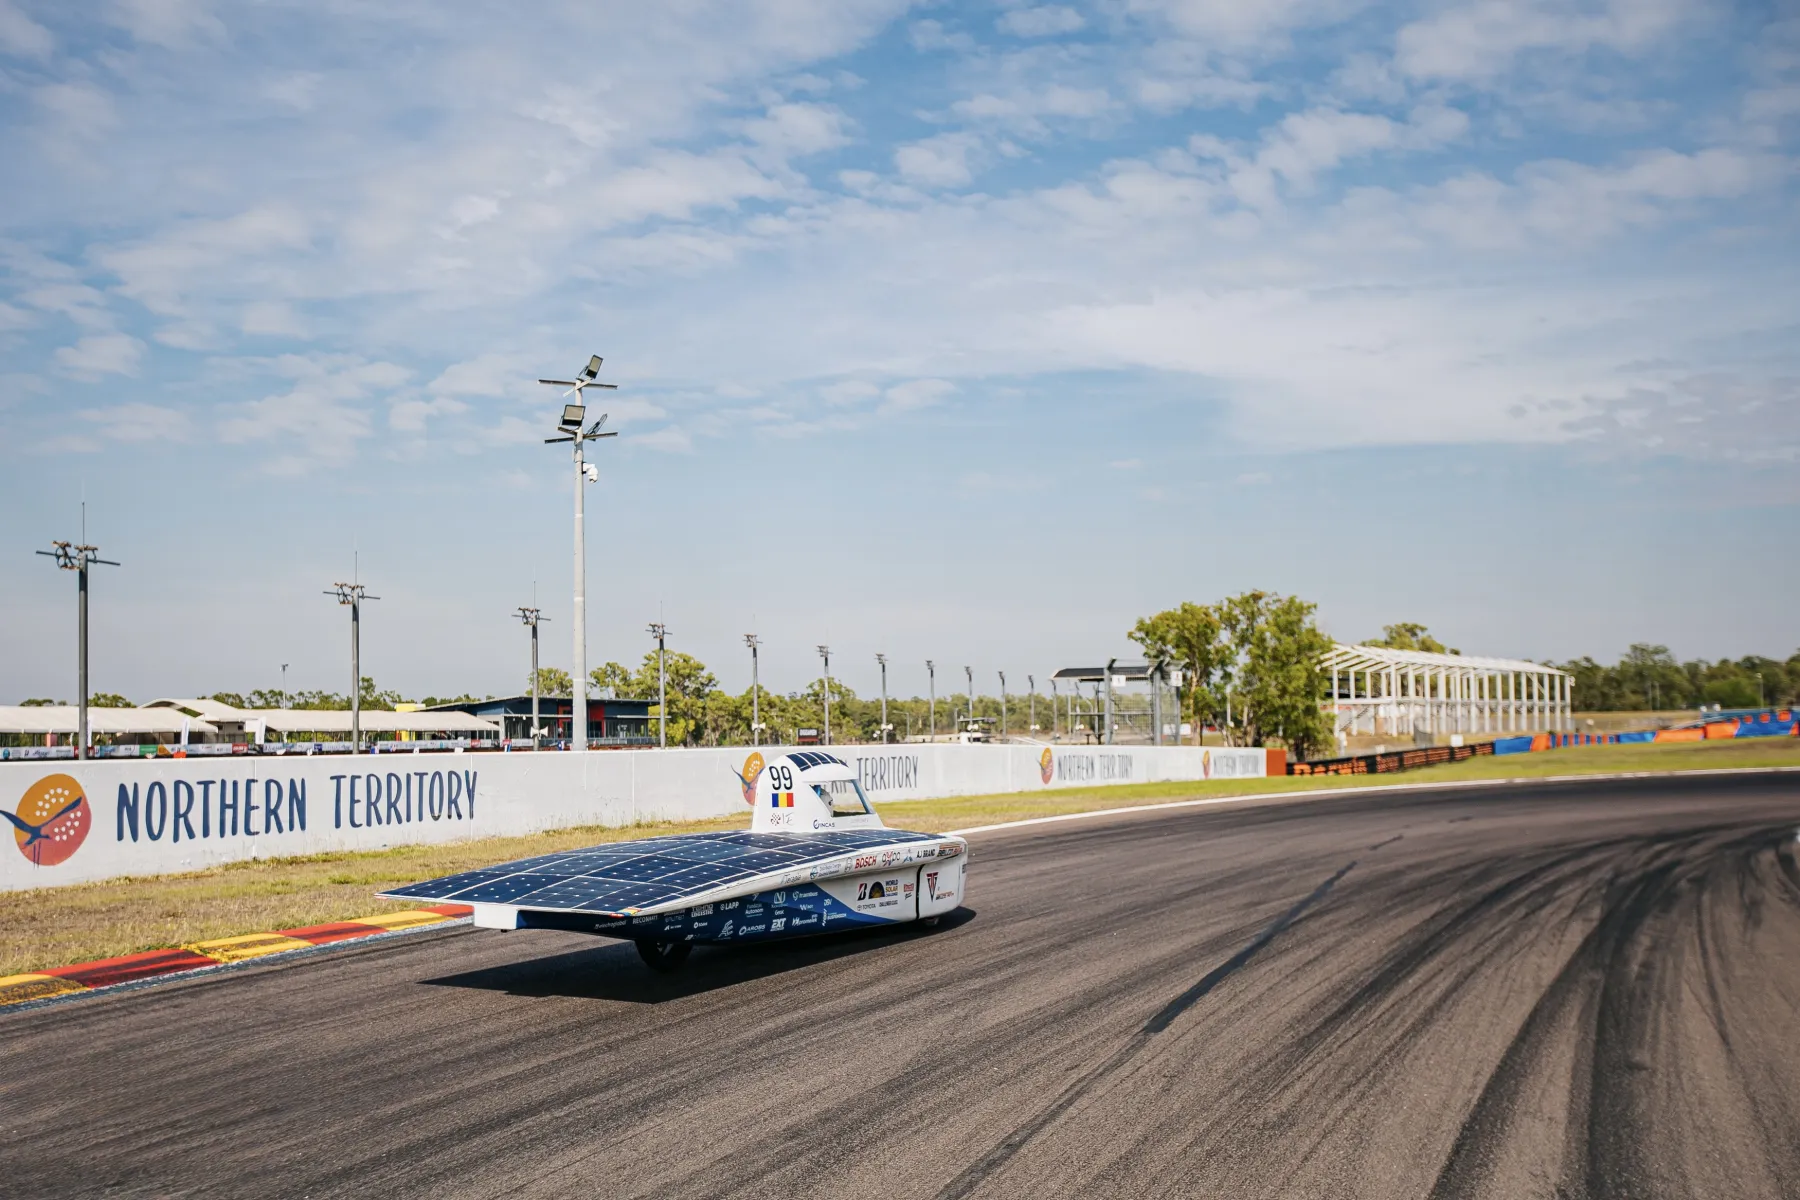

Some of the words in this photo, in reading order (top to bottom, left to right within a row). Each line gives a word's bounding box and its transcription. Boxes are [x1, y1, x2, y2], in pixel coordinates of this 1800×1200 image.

[769, 765, 793, 791] 99
[856, 755, 919, 792] TERRITORY
[1057, 754, 1096, 781] NORTHERN
[1099, 754, 1134, 780] TERRTORY
[116, 777, 307, 843] NORTHERN
[330, 770, 478, 829] TERRITORY
[855, 855, 877, 869] BOSCH
[725, 902, 739, 910] LAPP
